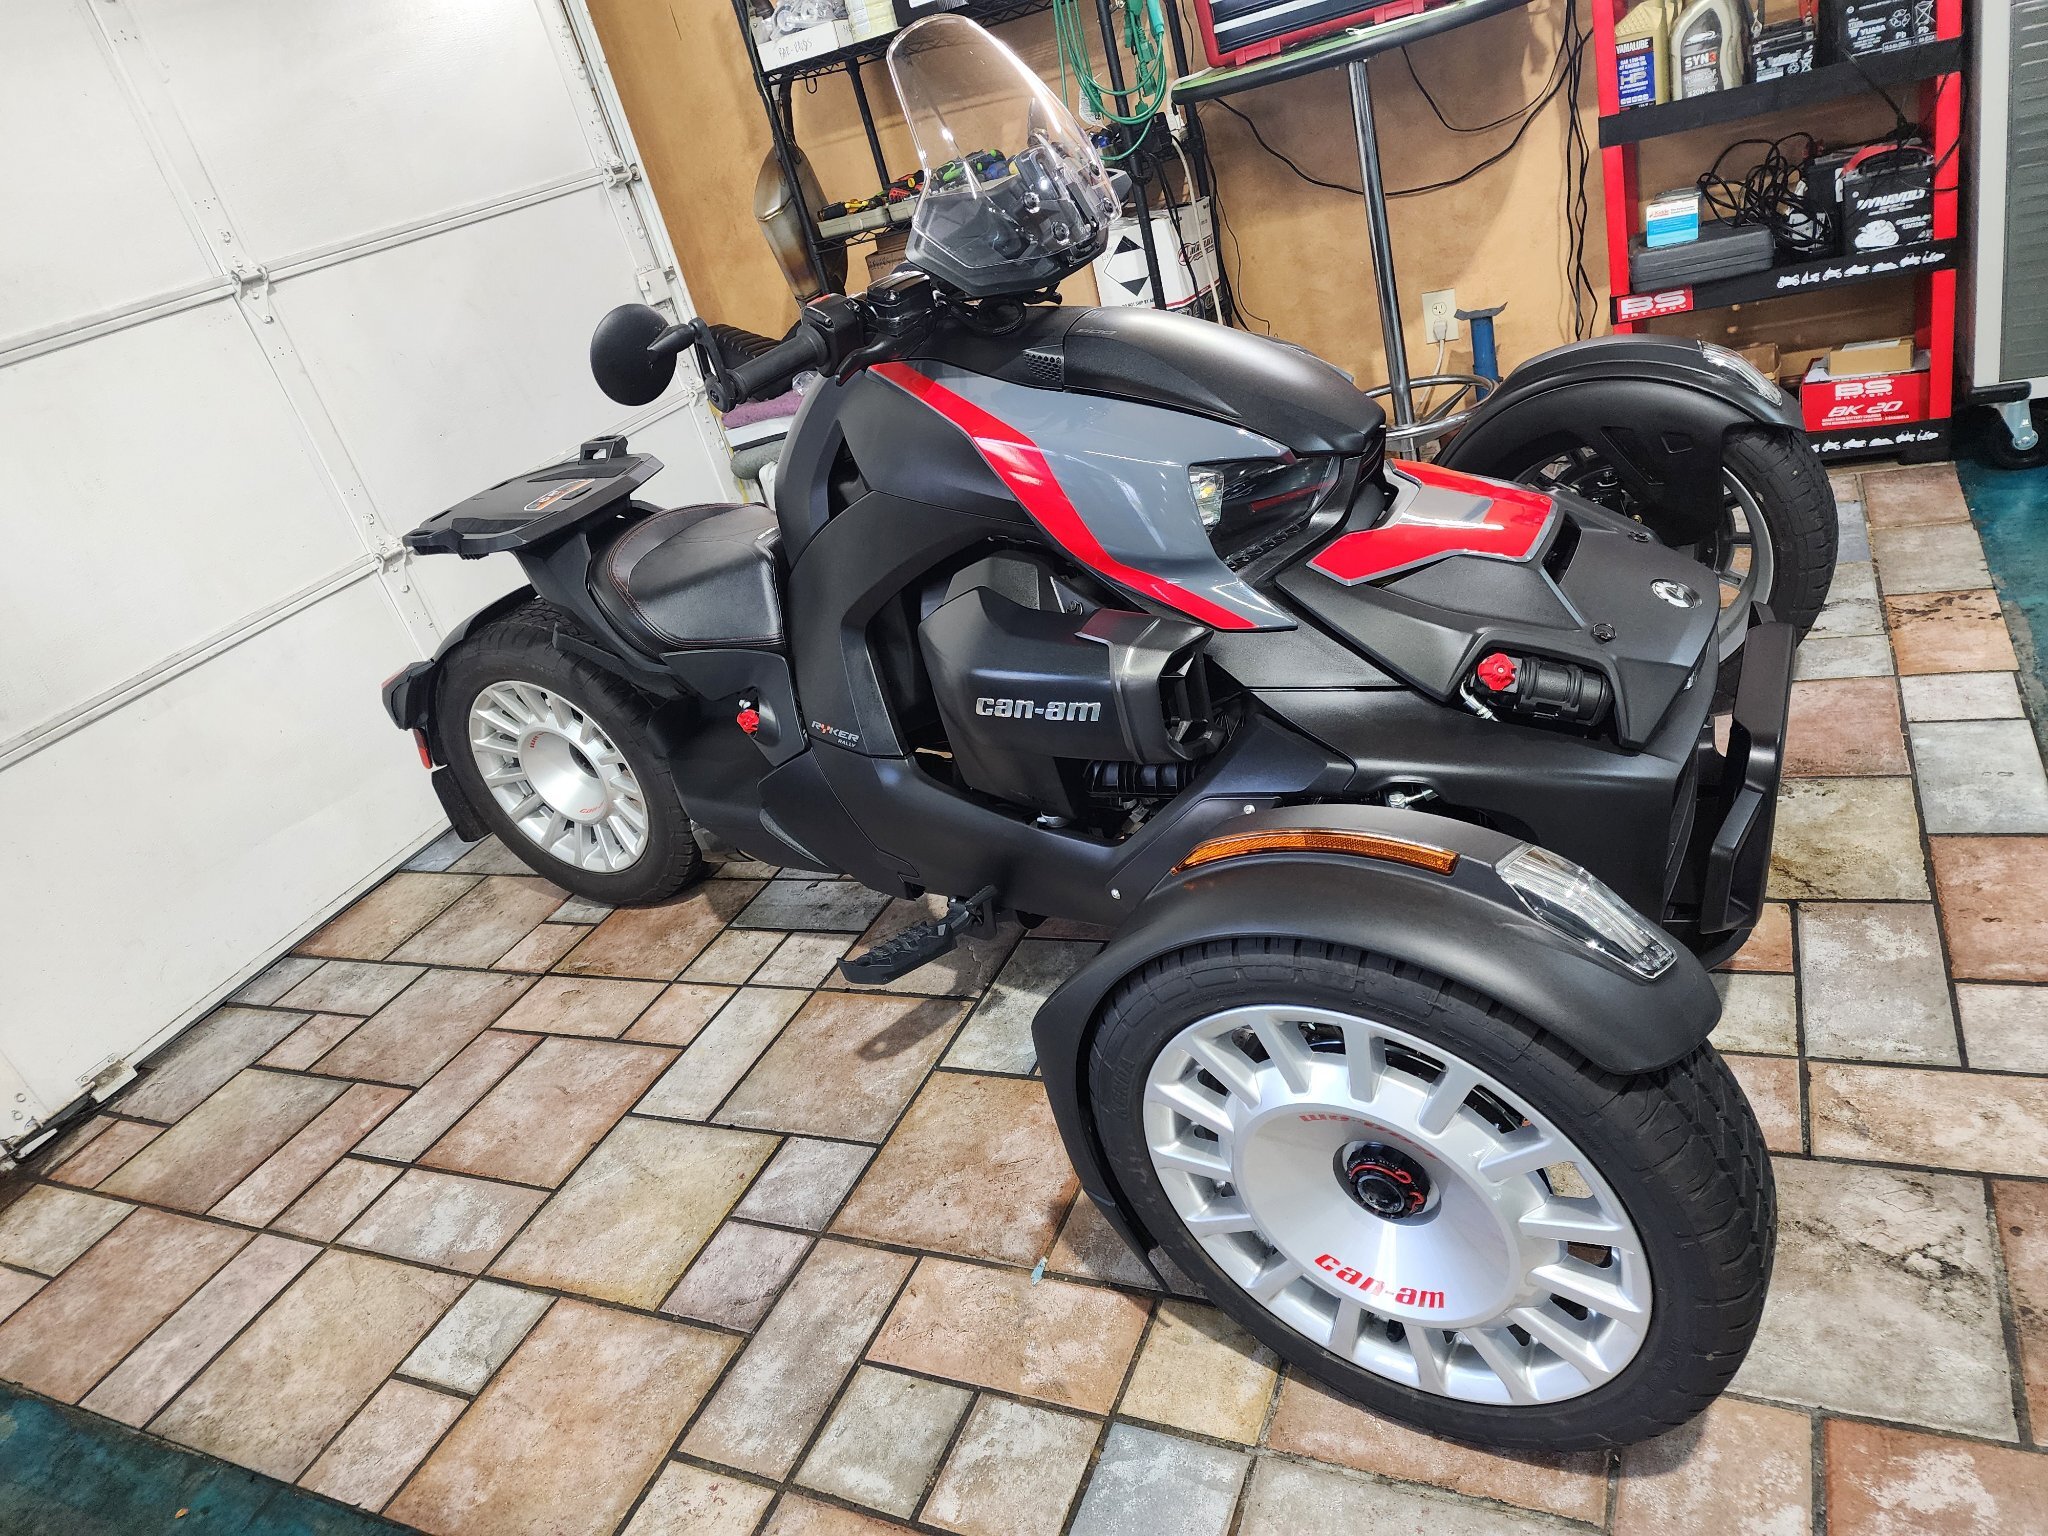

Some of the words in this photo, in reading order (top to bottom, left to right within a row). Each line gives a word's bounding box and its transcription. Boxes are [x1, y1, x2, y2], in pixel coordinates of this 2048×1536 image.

[1616, 39, 1649, 54] YAMALUBE
[1620, 289, 1687, 315] BS
[1834, 379, 1894, 398] BS
[1827, 404, 1865, 418] BK
[1866, 400, 1904, 414] 20
[975, 697, 1101, 722] can-am
[811, 720, 860, 743] RYKER
[837, 738, 857, 748] RALLY
[1314, 1253, 1445, 1309] can-am
